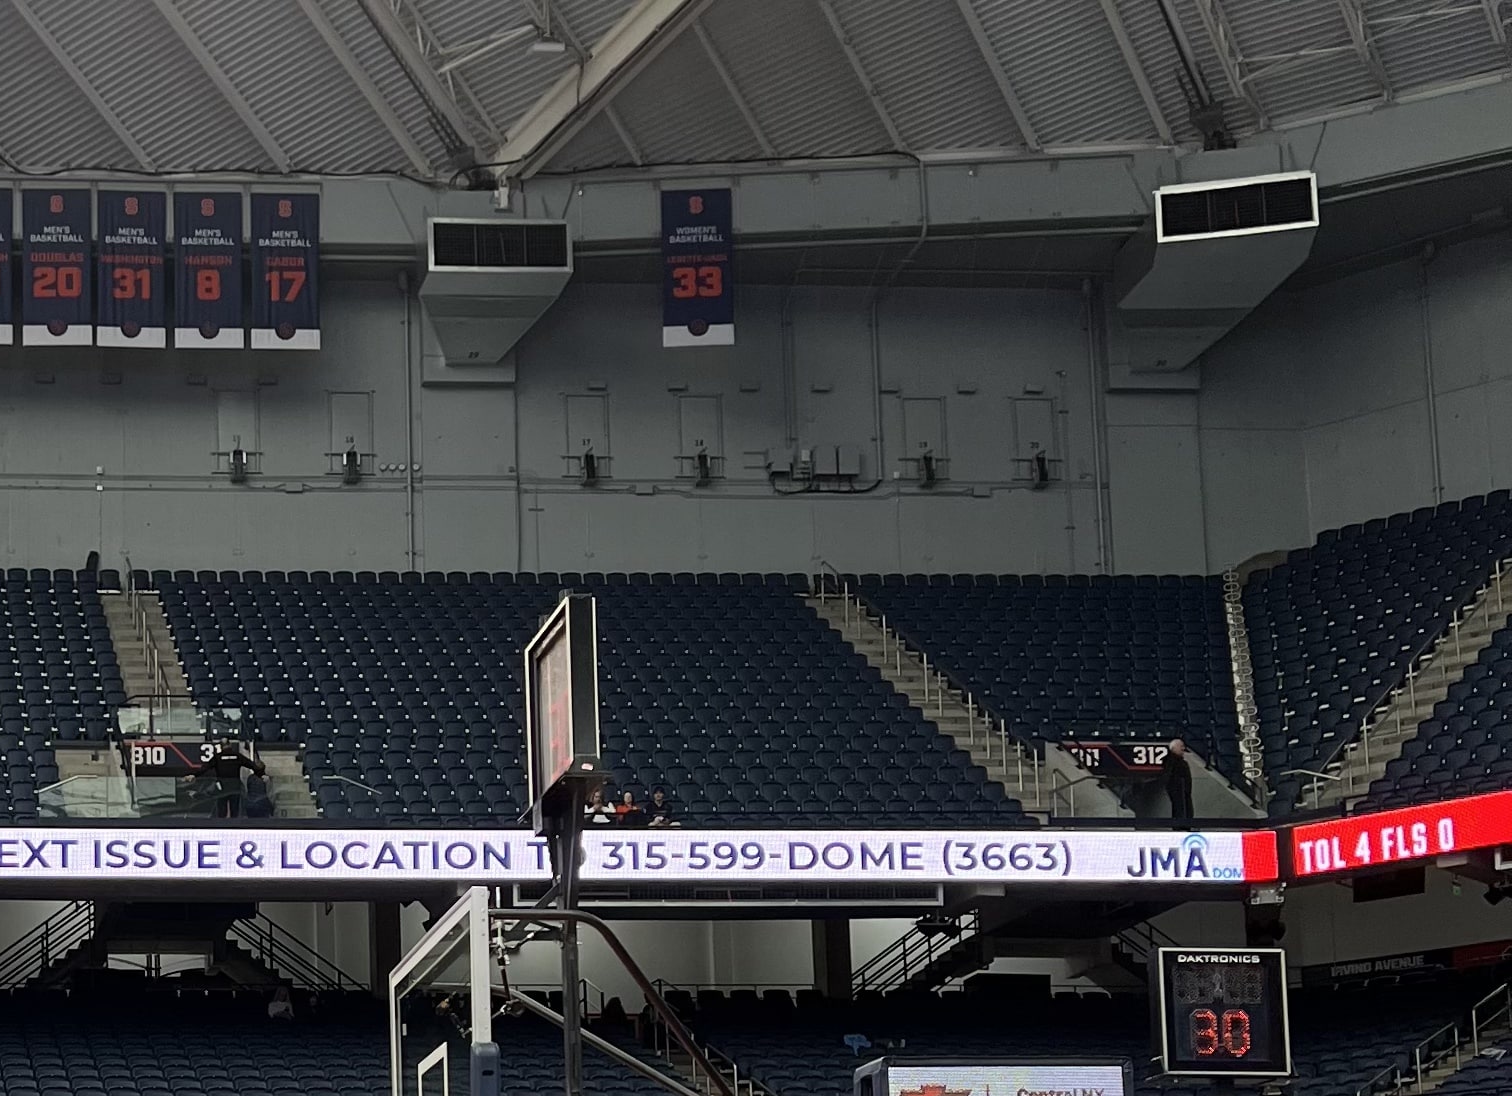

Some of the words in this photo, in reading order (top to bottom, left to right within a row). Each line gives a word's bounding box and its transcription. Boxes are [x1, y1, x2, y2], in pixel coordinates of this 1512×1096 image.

[43, 225, 70, 234] MEN'S
[118, 228, 145, 236] MEN'S
[194, 229, 222, 237] MEN'S
[272, 231, 299, 239] MEN'S
[676, 226, 717, 235] WOMEN'S
[30, 233, 84, 243] BASKETBALL
[105, 235, 158, 245] BASKETBALL
[182, 236, 234, 246] BASKETBALL
[258, 238, 311, 247] BASKETBALL
[669, 234, 724, 244] BASKETBALL
[32, 266, 82, 298] 20
[113, 268, 150, 299] 31
[196, 269, 221, 301] 8
[265, 271, 306, 302] 17
[672, 266, 722, 299] 33
[1133, 746, 1168, 765] 312
[1300, 841, 1346, 873] TOL
[1354, 831, 1371, 865] 4
[1380, 822, 1428, 860] FLS
[1438, 818, 1455, 851] 0
[93, 839, 220, 870] ISSUE
[235, 839, 264, 870] &
[282, 840, 511, 871] LOCATION
[602, 840, 924, 872] 315-599-DOME
[942, 839, 1073, 876] (3663)
[1128, 846, 1209, 878] JMA
[1213, 866, 1244, 879] DOM
[1177, 953, 1260, 964] DAKTRONICS
[1375, 955, 1424, 971] AVENUE
[1190, 1009, 1251, 1058] 30
